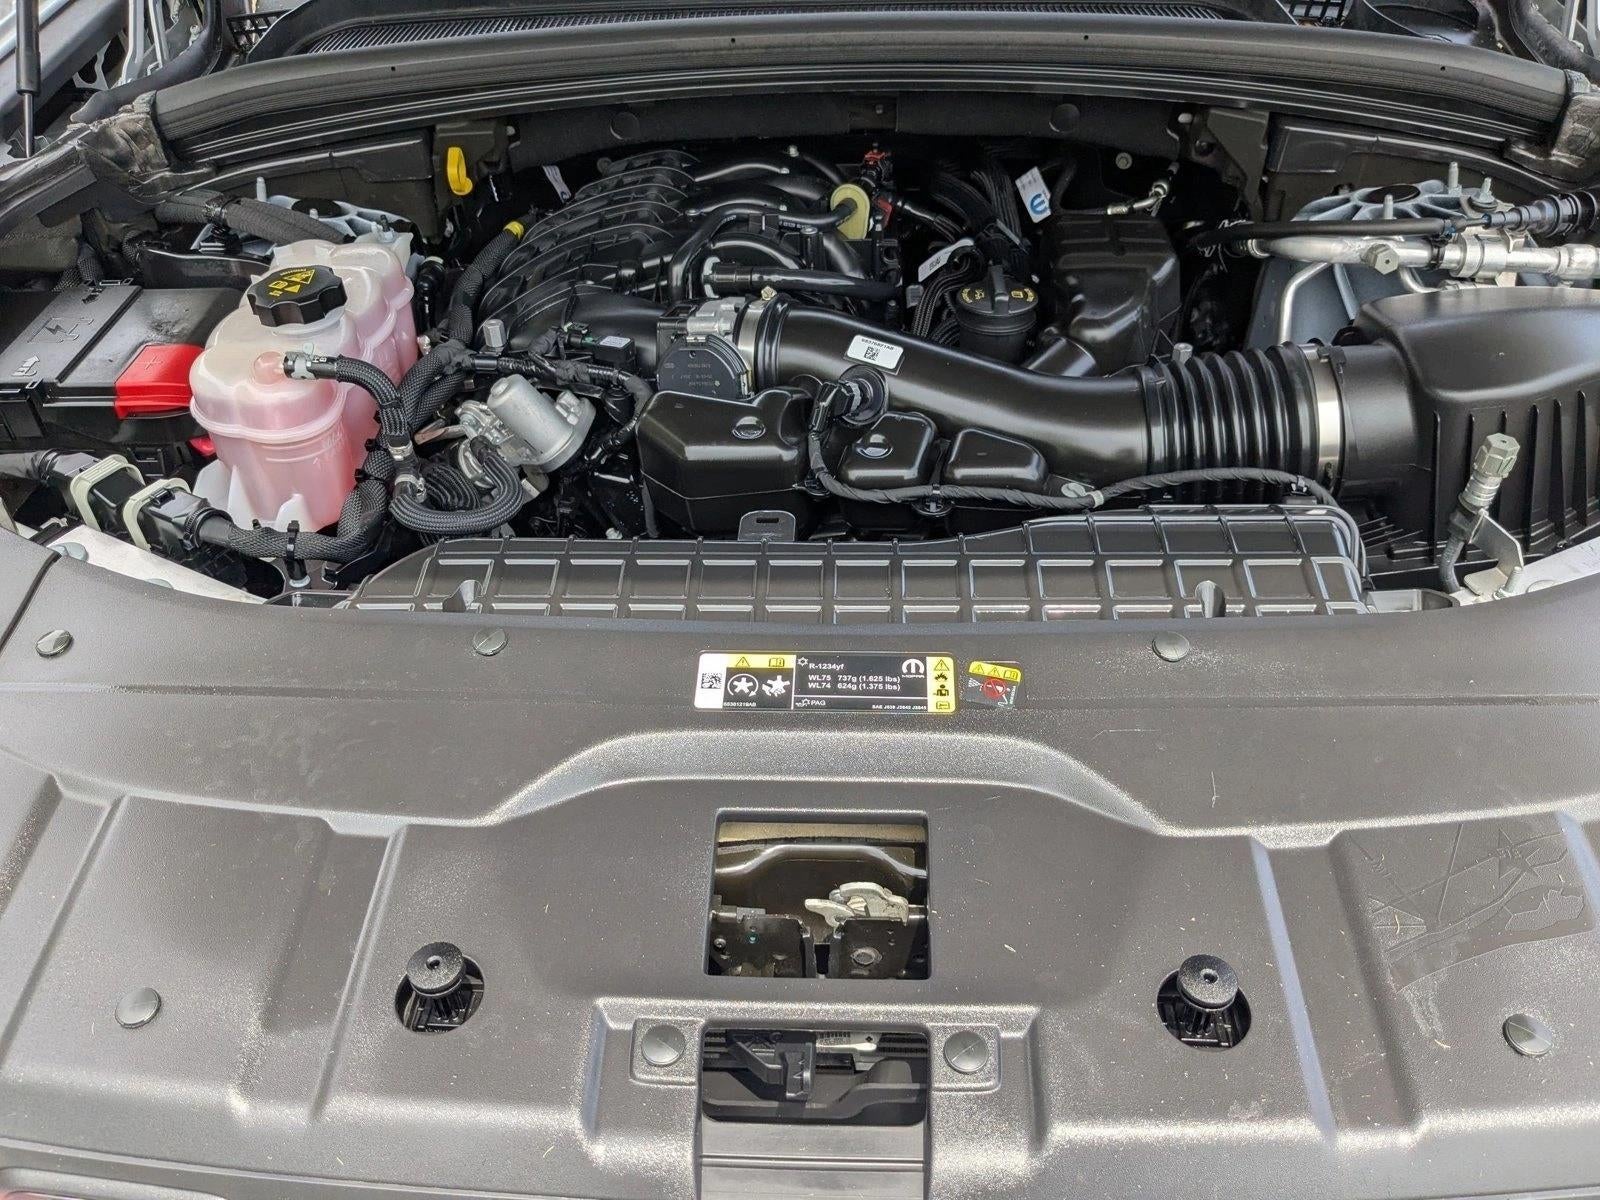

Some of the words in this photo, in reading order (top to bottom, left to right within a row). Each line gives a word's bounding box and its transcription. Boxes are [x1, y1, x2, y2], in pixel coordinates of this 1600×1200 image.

[809, 662, 844, 671] R-1234yf
[837, 674, 857, 683] 737g
[858, 674, 883, 683] (1.625
[885, 674, 901, 684] lbs)
[837, 682, 857, 691] 624g
[858, 682, 883, 691] (1.375
[885, 683, 901, 692] lbs)
